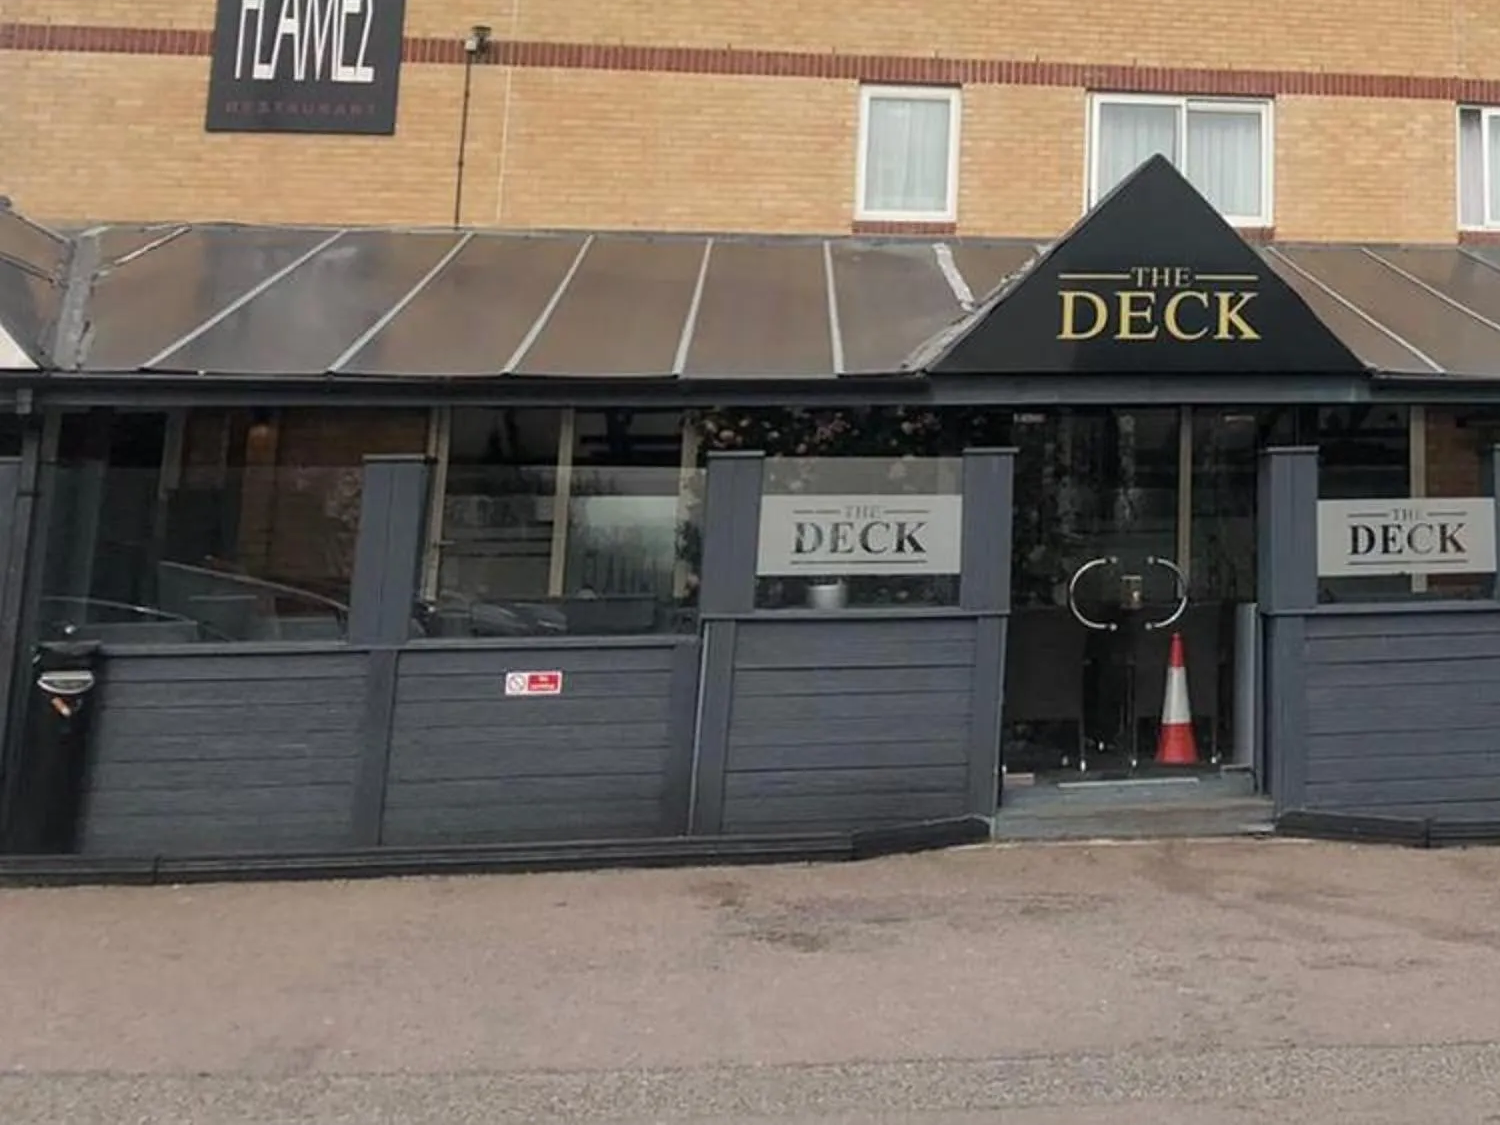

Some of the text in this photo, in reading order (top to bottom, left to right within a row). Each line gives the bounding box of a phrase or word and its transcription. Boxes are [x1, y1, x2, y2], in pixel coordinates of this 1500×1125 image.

[1131, 266, 1191, 288] THE
[1056, 290, 1262, 340] DECK
[843, 504, 881, 520] THE
[792, 521, 928, 555] DECK
[1348, 522, 1467, 556] DECK
